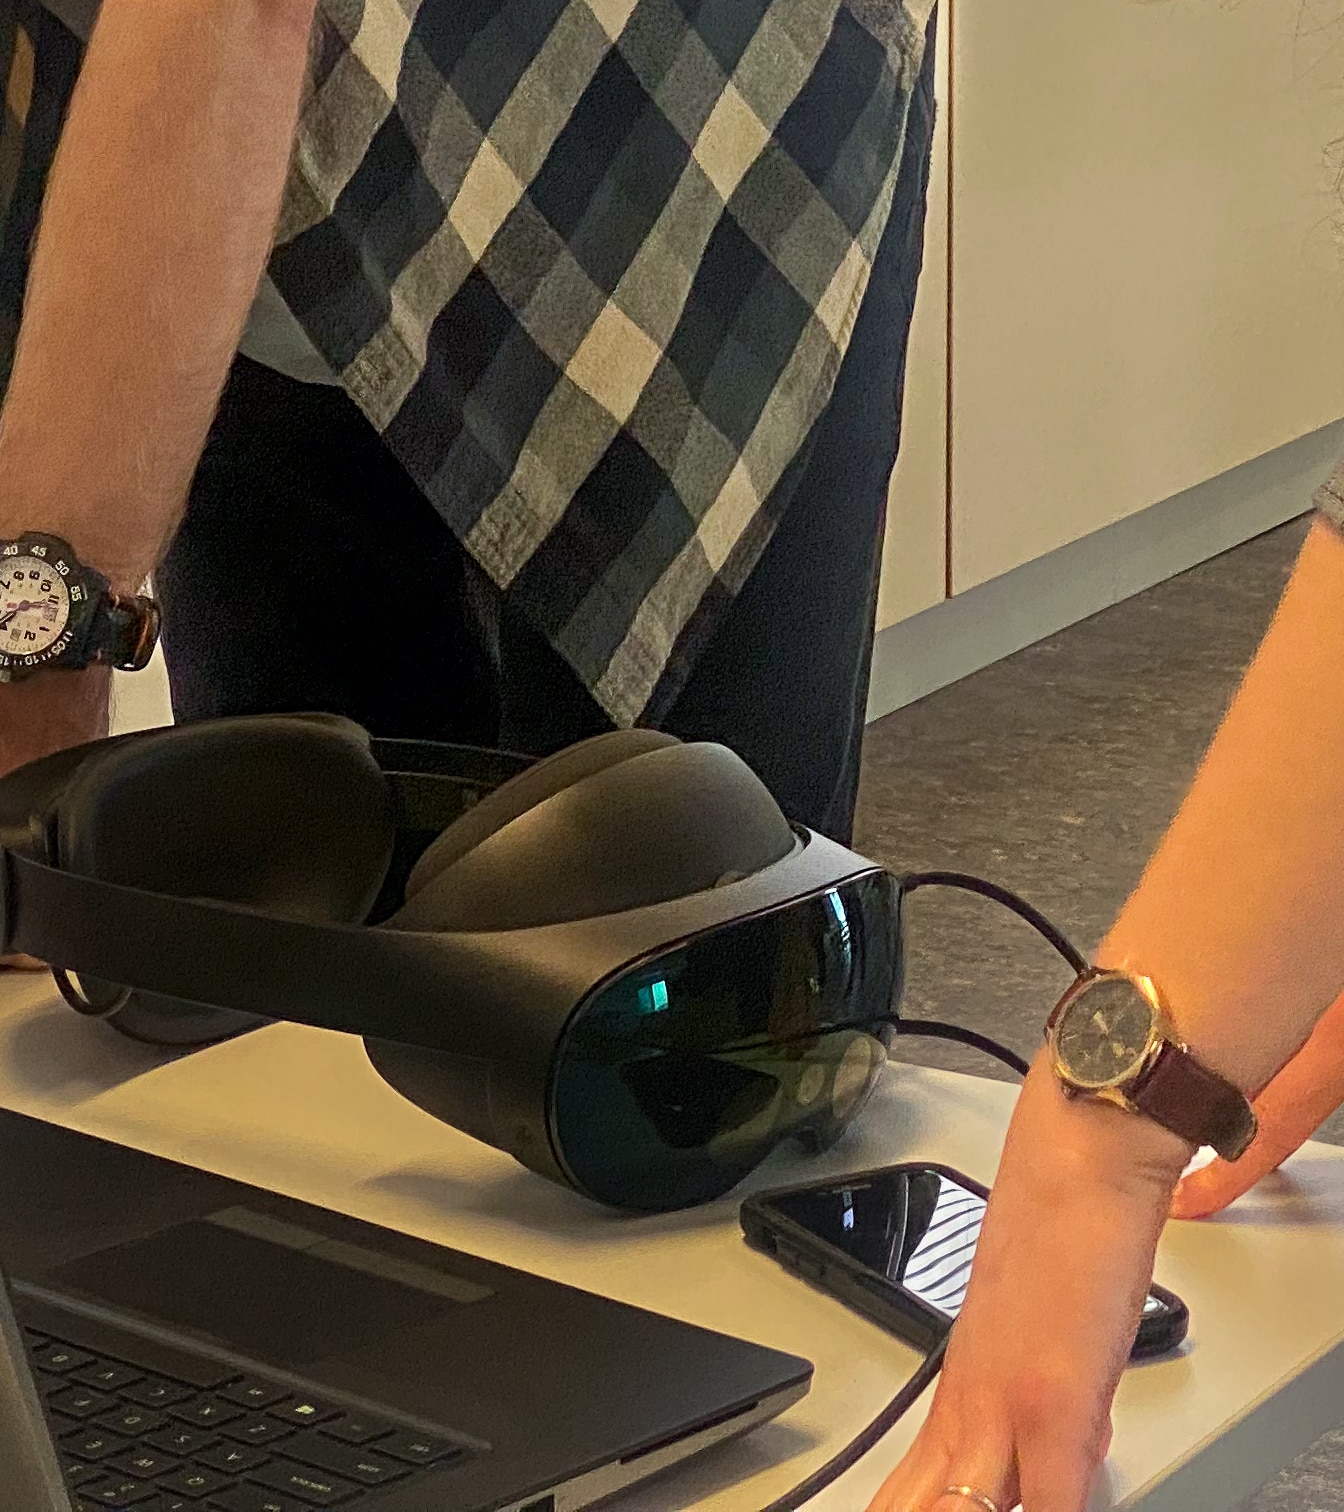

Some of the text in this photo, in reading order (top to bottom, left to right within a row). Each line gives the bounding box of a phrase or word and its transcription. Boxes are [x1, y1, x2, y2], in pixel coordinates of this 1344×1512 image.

[3, 545, 19, 556] 40
[31, 545, 47, 557] 45
[54, 560, 70, 576] 50
[24, 655, 40, 666] 10
